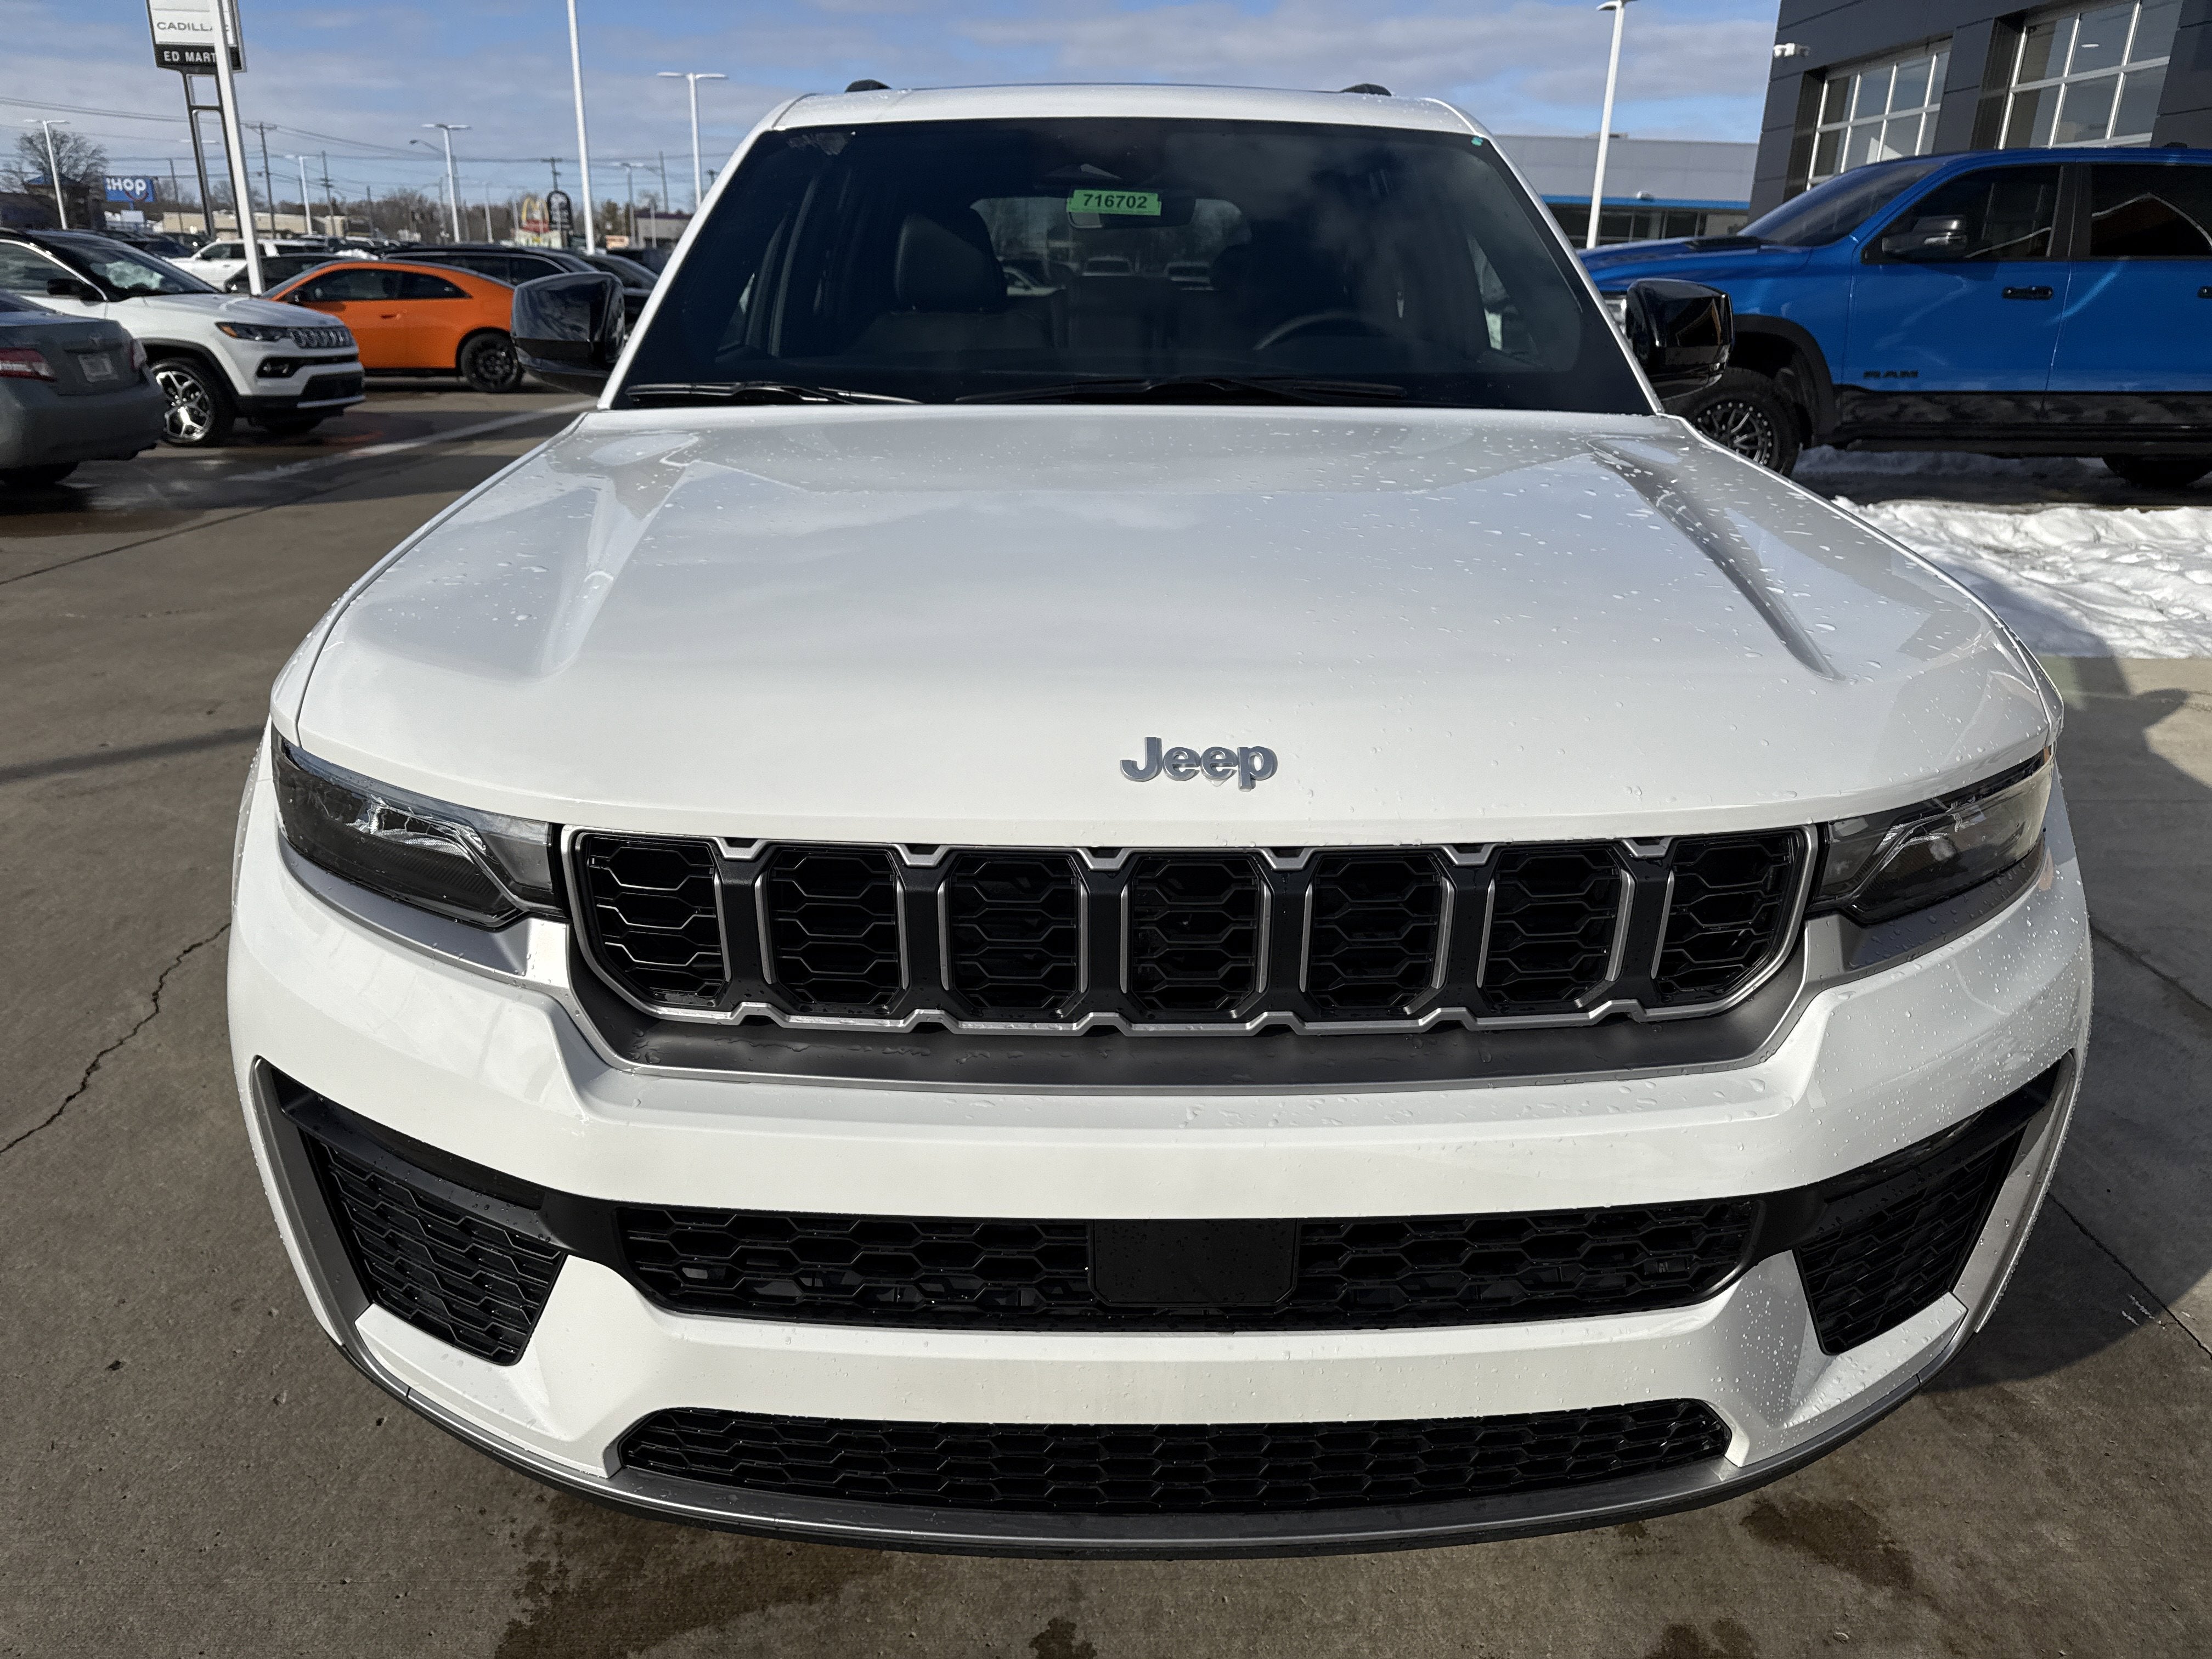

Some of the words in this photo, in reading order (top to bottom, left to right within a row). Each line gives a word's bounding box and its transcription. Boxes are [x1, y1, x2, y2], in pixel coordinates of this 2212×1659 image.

[157, 21, 229, 32] CADILL
[163, 50, 180, 62] ED
[184, 51, 216, 63] MART
[1083, 194, 1148, 209] 716702
[1120, 737, 1277, 792] Jeep
